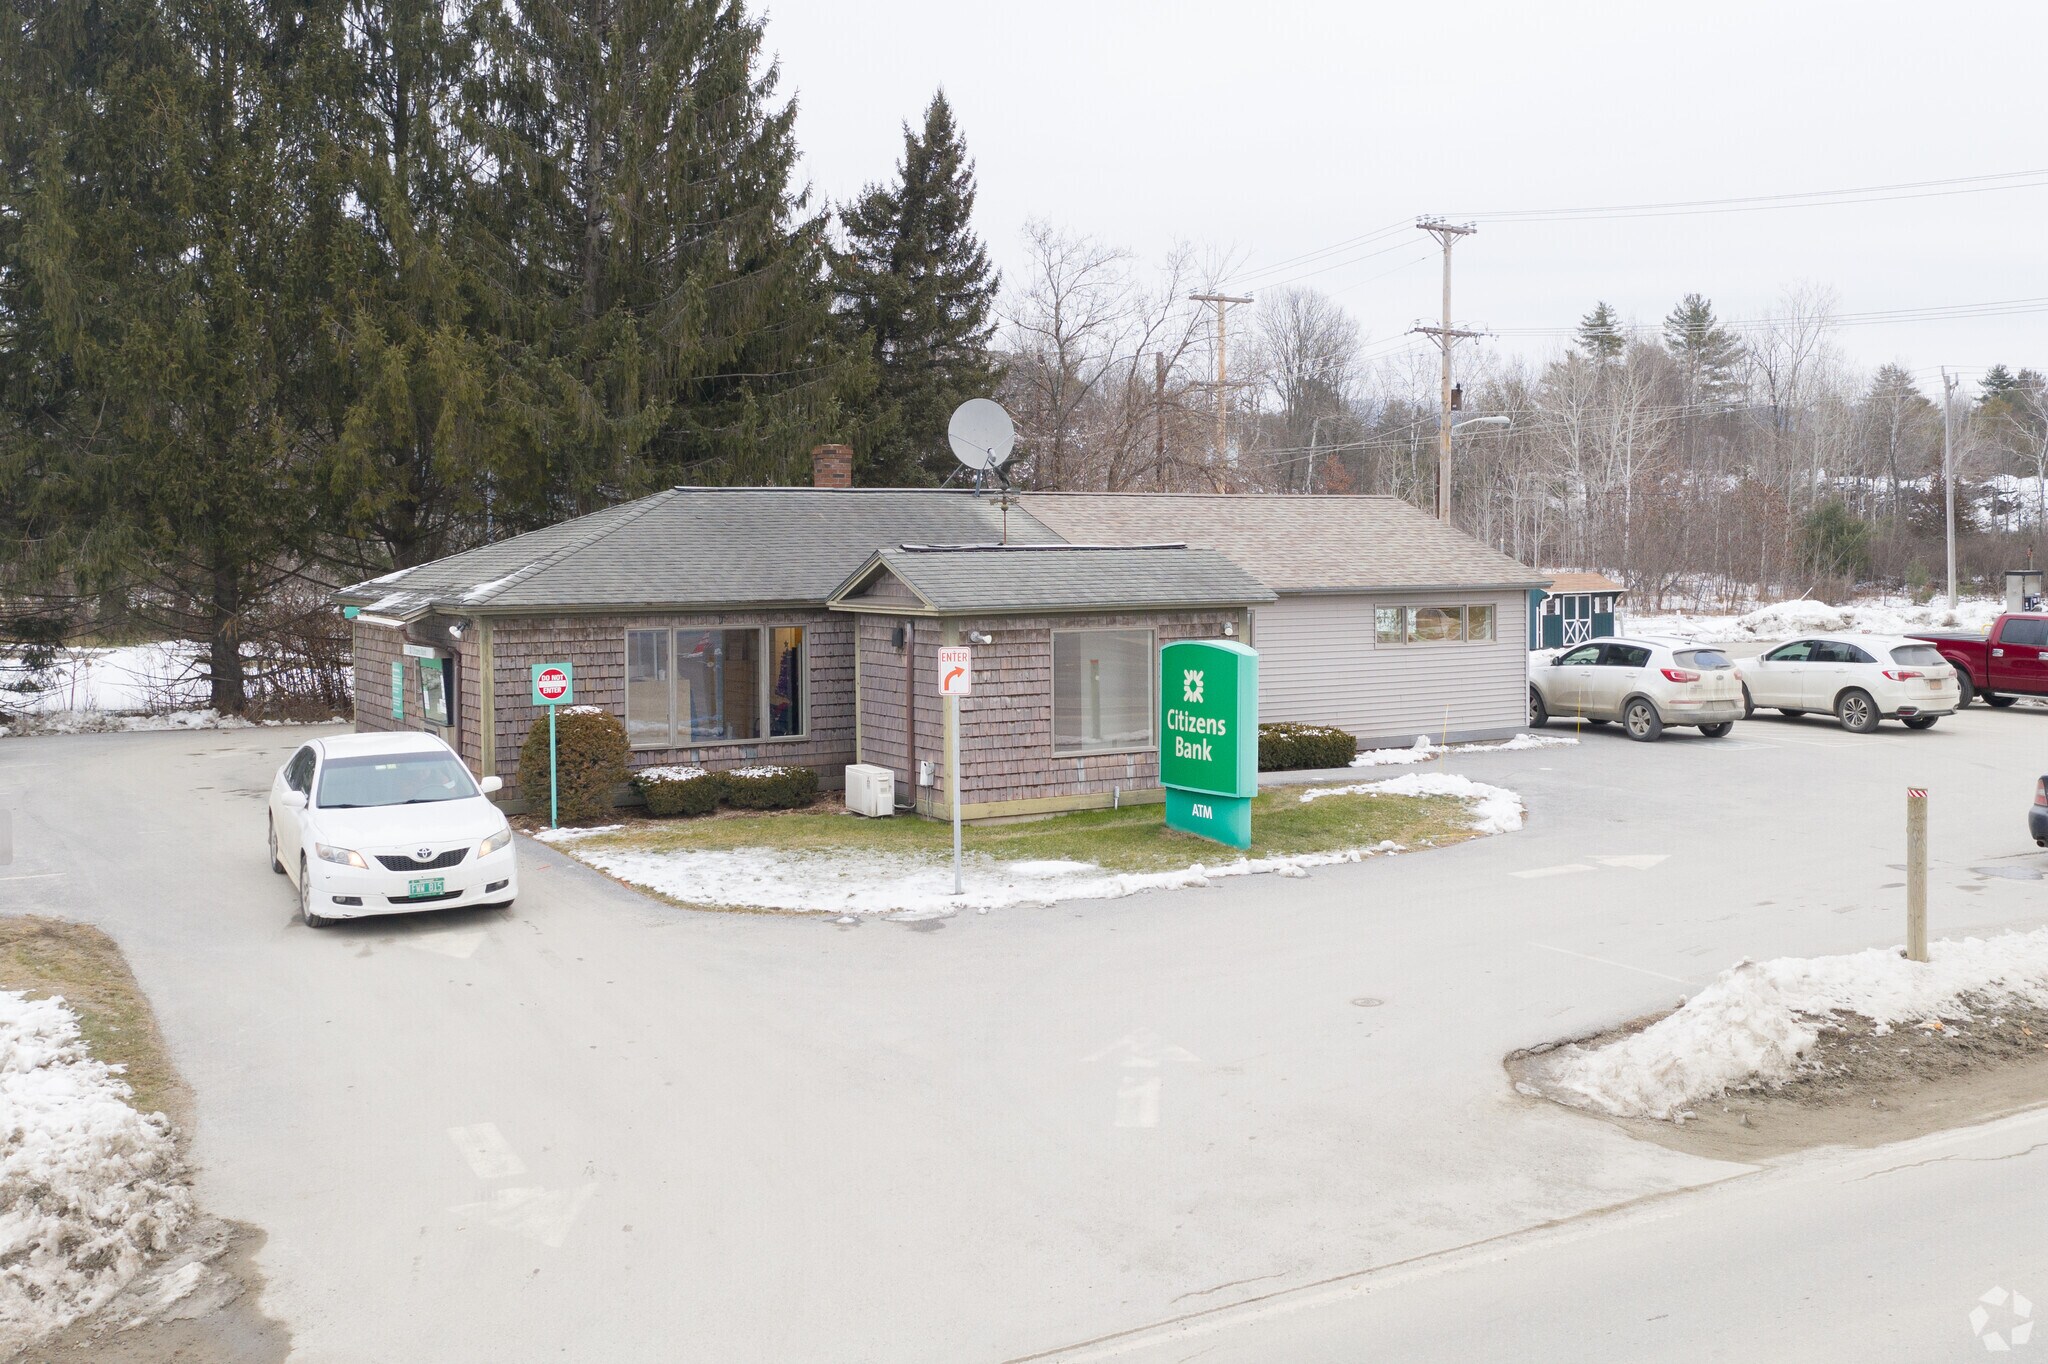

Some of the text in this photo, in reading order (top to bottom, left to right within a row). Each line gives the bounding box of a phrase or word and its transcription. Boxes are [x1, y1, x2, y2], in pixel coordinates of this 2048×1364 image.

[941, 652, 967, 662] ENTER
[1167, 708, 1226, 736] Citizens
[1175, 736, 1212, 762] Bank
[1191, 803, 1213, 820] ATM
